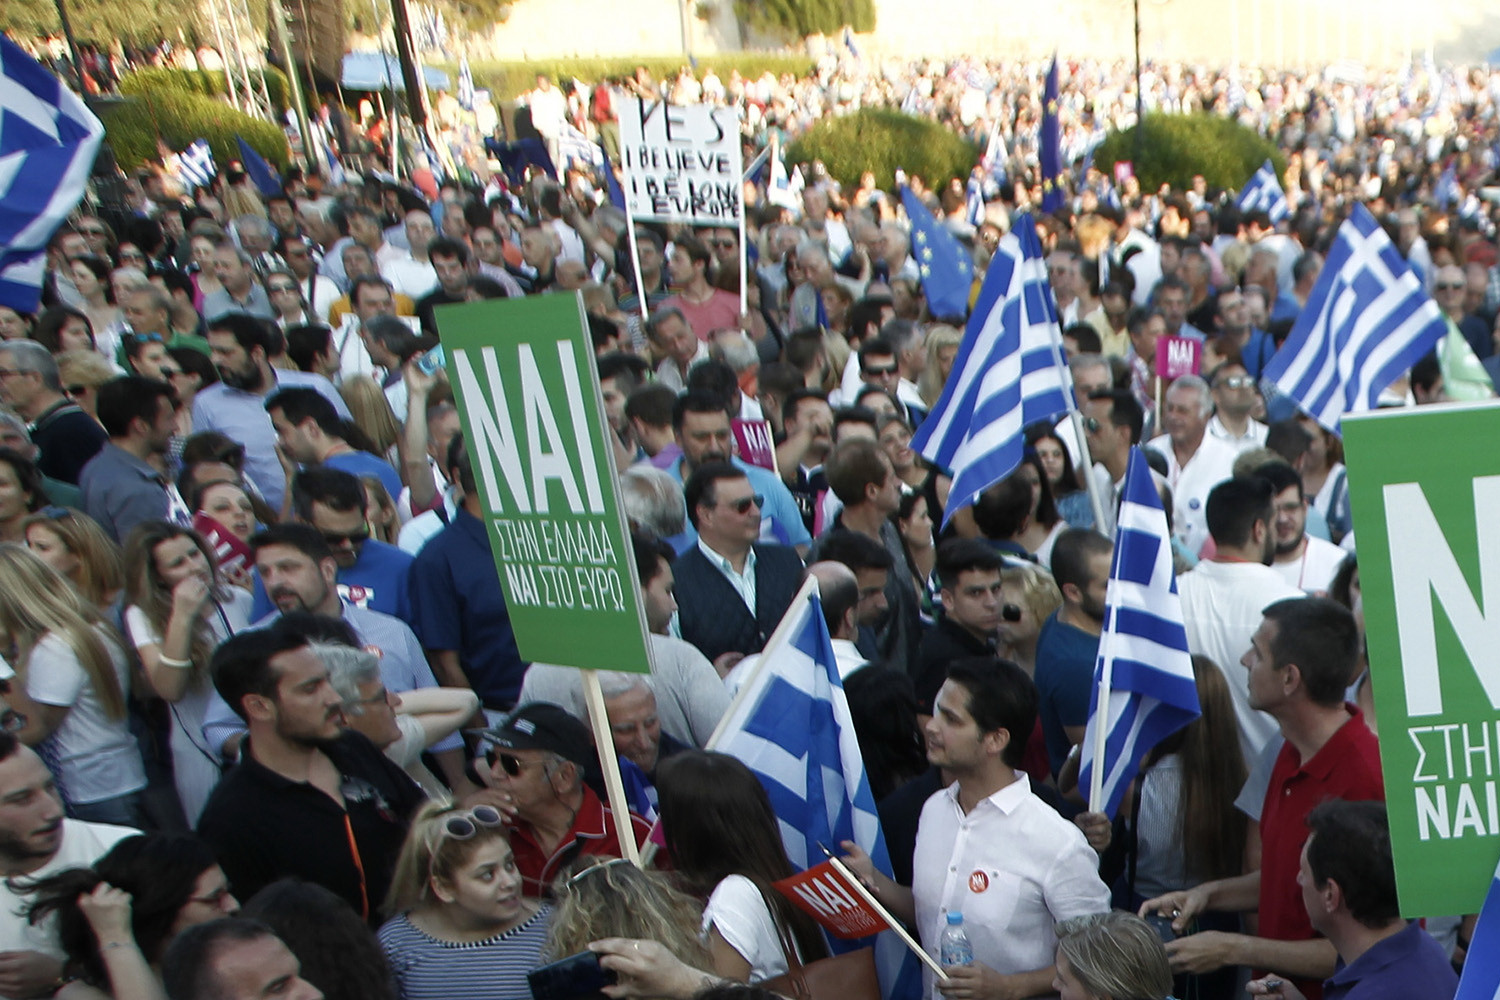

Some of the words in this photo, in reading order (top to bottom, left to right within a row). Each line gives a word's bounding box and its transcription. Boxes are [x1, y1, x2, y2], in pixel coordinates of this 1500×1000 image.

[637, 95, 724, 144] YES
[625, 145, 631, 168] I
[639, 145, 731, 176] BELIEVE
[632, 176, 637, 195] I
[651, 195, 740, 217] EUROPE
[453, 338, 606, 515] ΝΑΙ
[493, 518, 542, 562] ΣΤΗΝ
[540, 519, 617, 565] ΕΛΛΑΔΑ
[504, 563, 540, 607] ΝΑΙ
[538, 564, 574, 609] ΣΤΟ
[574, 566, 626, 612] ΕΥΡΩ
[1414, 780, 1499, 840] ΝΑΙ
[793, 872, 858, 917] ΝΑΙ
